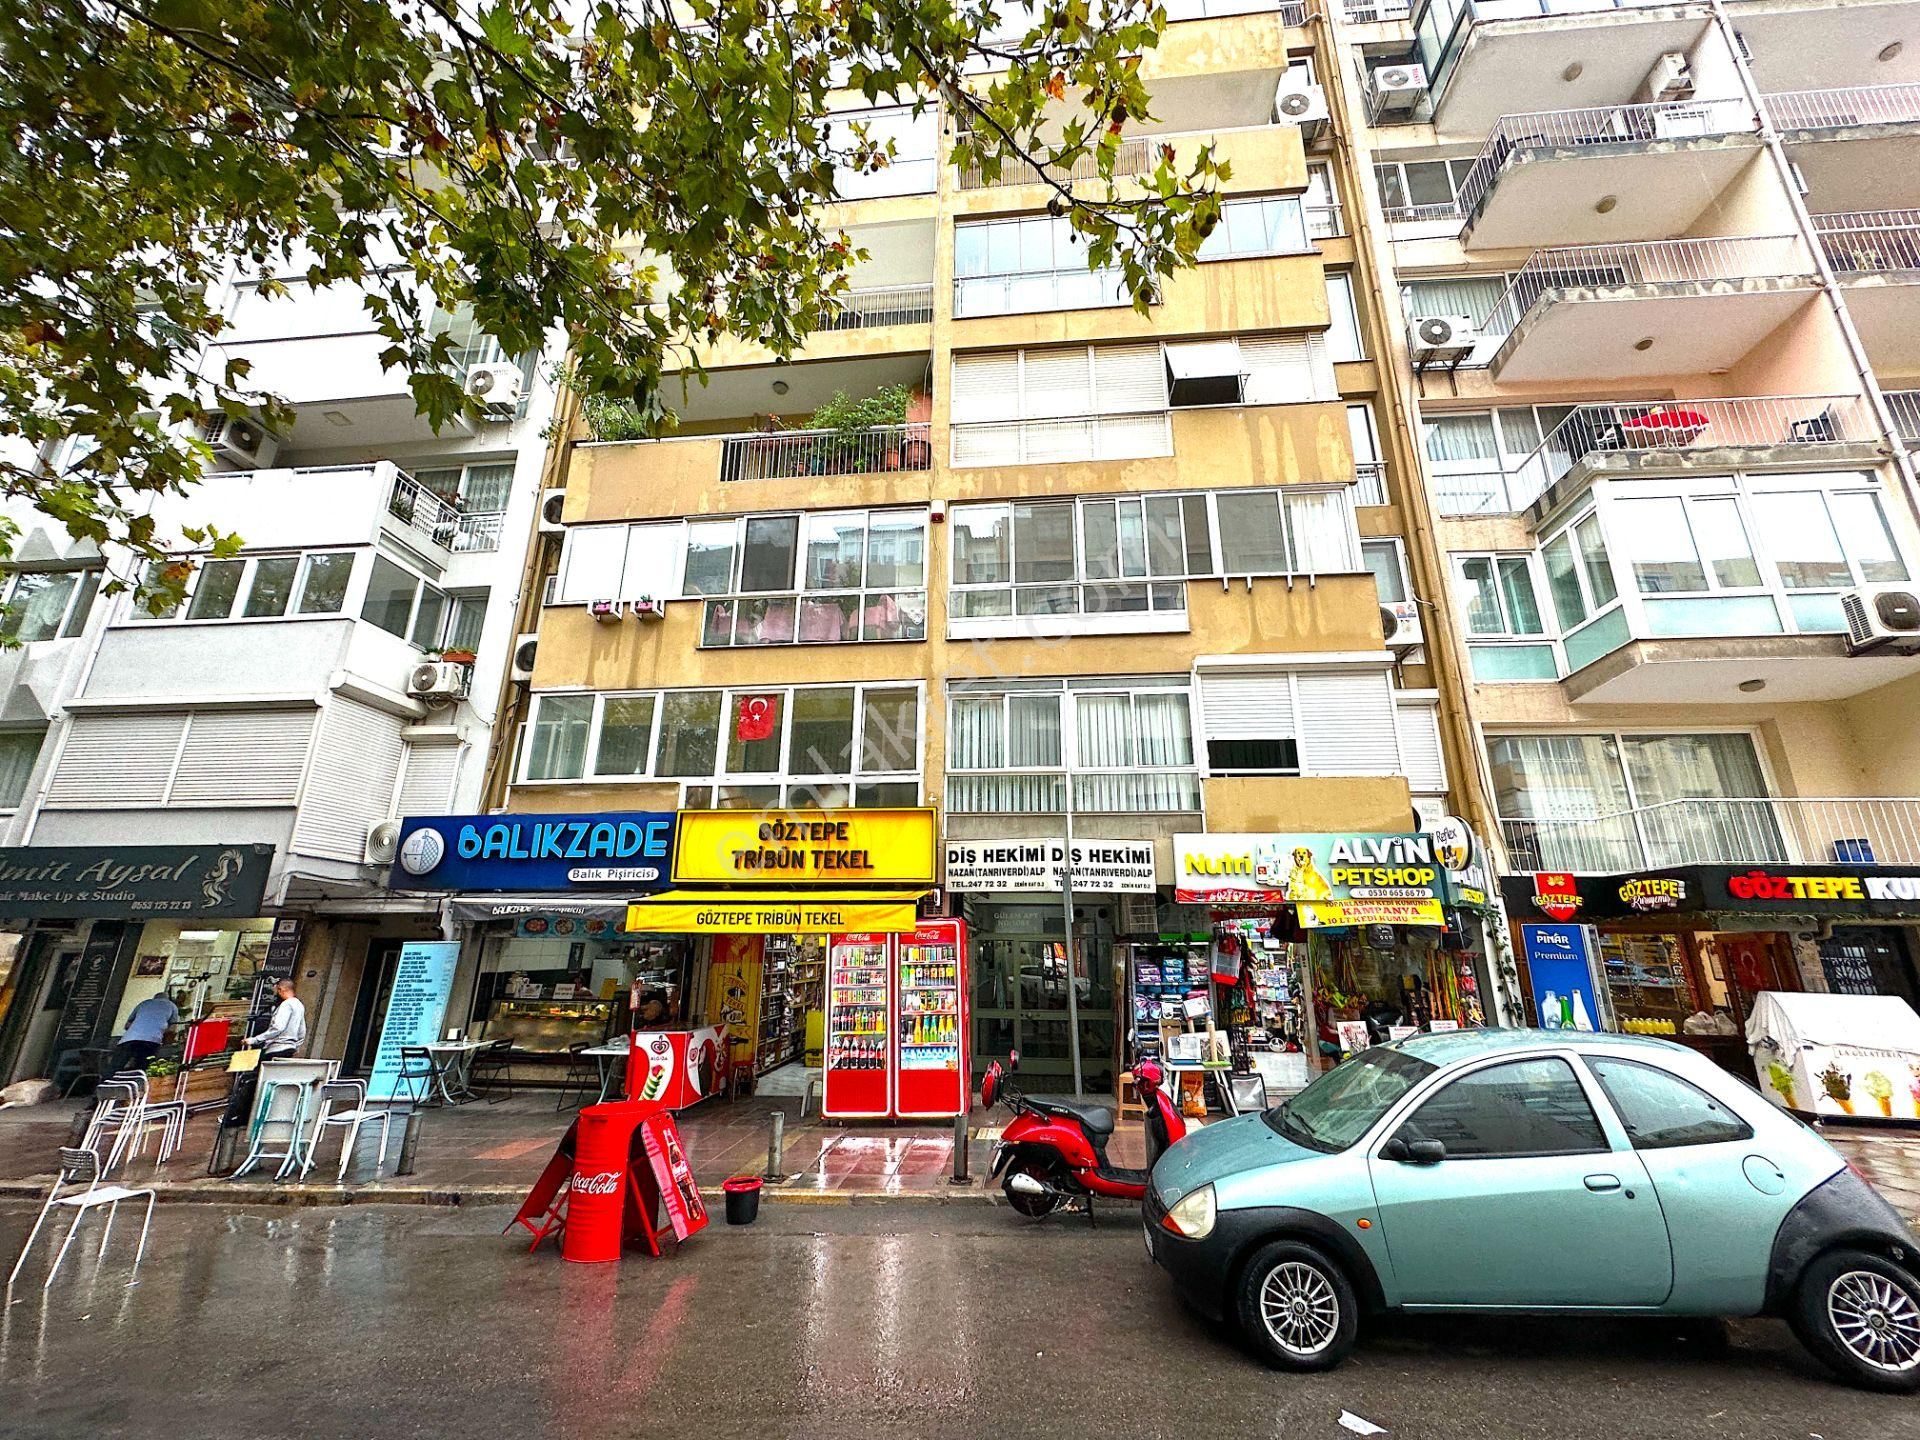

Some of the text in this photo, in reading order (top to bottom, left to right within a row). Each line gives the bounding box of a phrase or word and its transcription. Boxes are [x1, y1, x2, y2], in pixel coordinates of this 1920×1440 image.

[758, 817, 849, 841] GÖZTEPE
[1436, 827, 1457, 844] Reflex
[731, 845, 874, 869] TRİBÜN TEKEL
[948, 845, 1045, 866] DİŞ HEKİMİ
[1052, 847, 1151, 865] DŞ HEKİMİ
[1185, 851, 1252, 875] Nutri
[572, 868, 655, 880] Balık Pişiricisi
[1331, 867, 1436, 886] PETSHOP
[1368, 889, 1388, 897] 0530
[1389, 889, 1404, 897] 665
[1618, 879, 1679, 902] GÖZTEPE
[1729, 870, 1866, 899] GÖZTEPE
[17, 891, 50, 901] Make
[55, 892, 73, 904] Up
[77, 891, 88, 901] &
[91, 890, 136, 901] Studio
[1535, 893, 1583, 907] GÖZTEPE
[697, 909, 844, 925] GÖZTEPE TRİBÜN TEKEL
[1343, 907, 1420, 915] KAMPANYA
[1534, 951, 1578, 961] Premium
[571, 1171, 623, 1194] Coca-Cola
